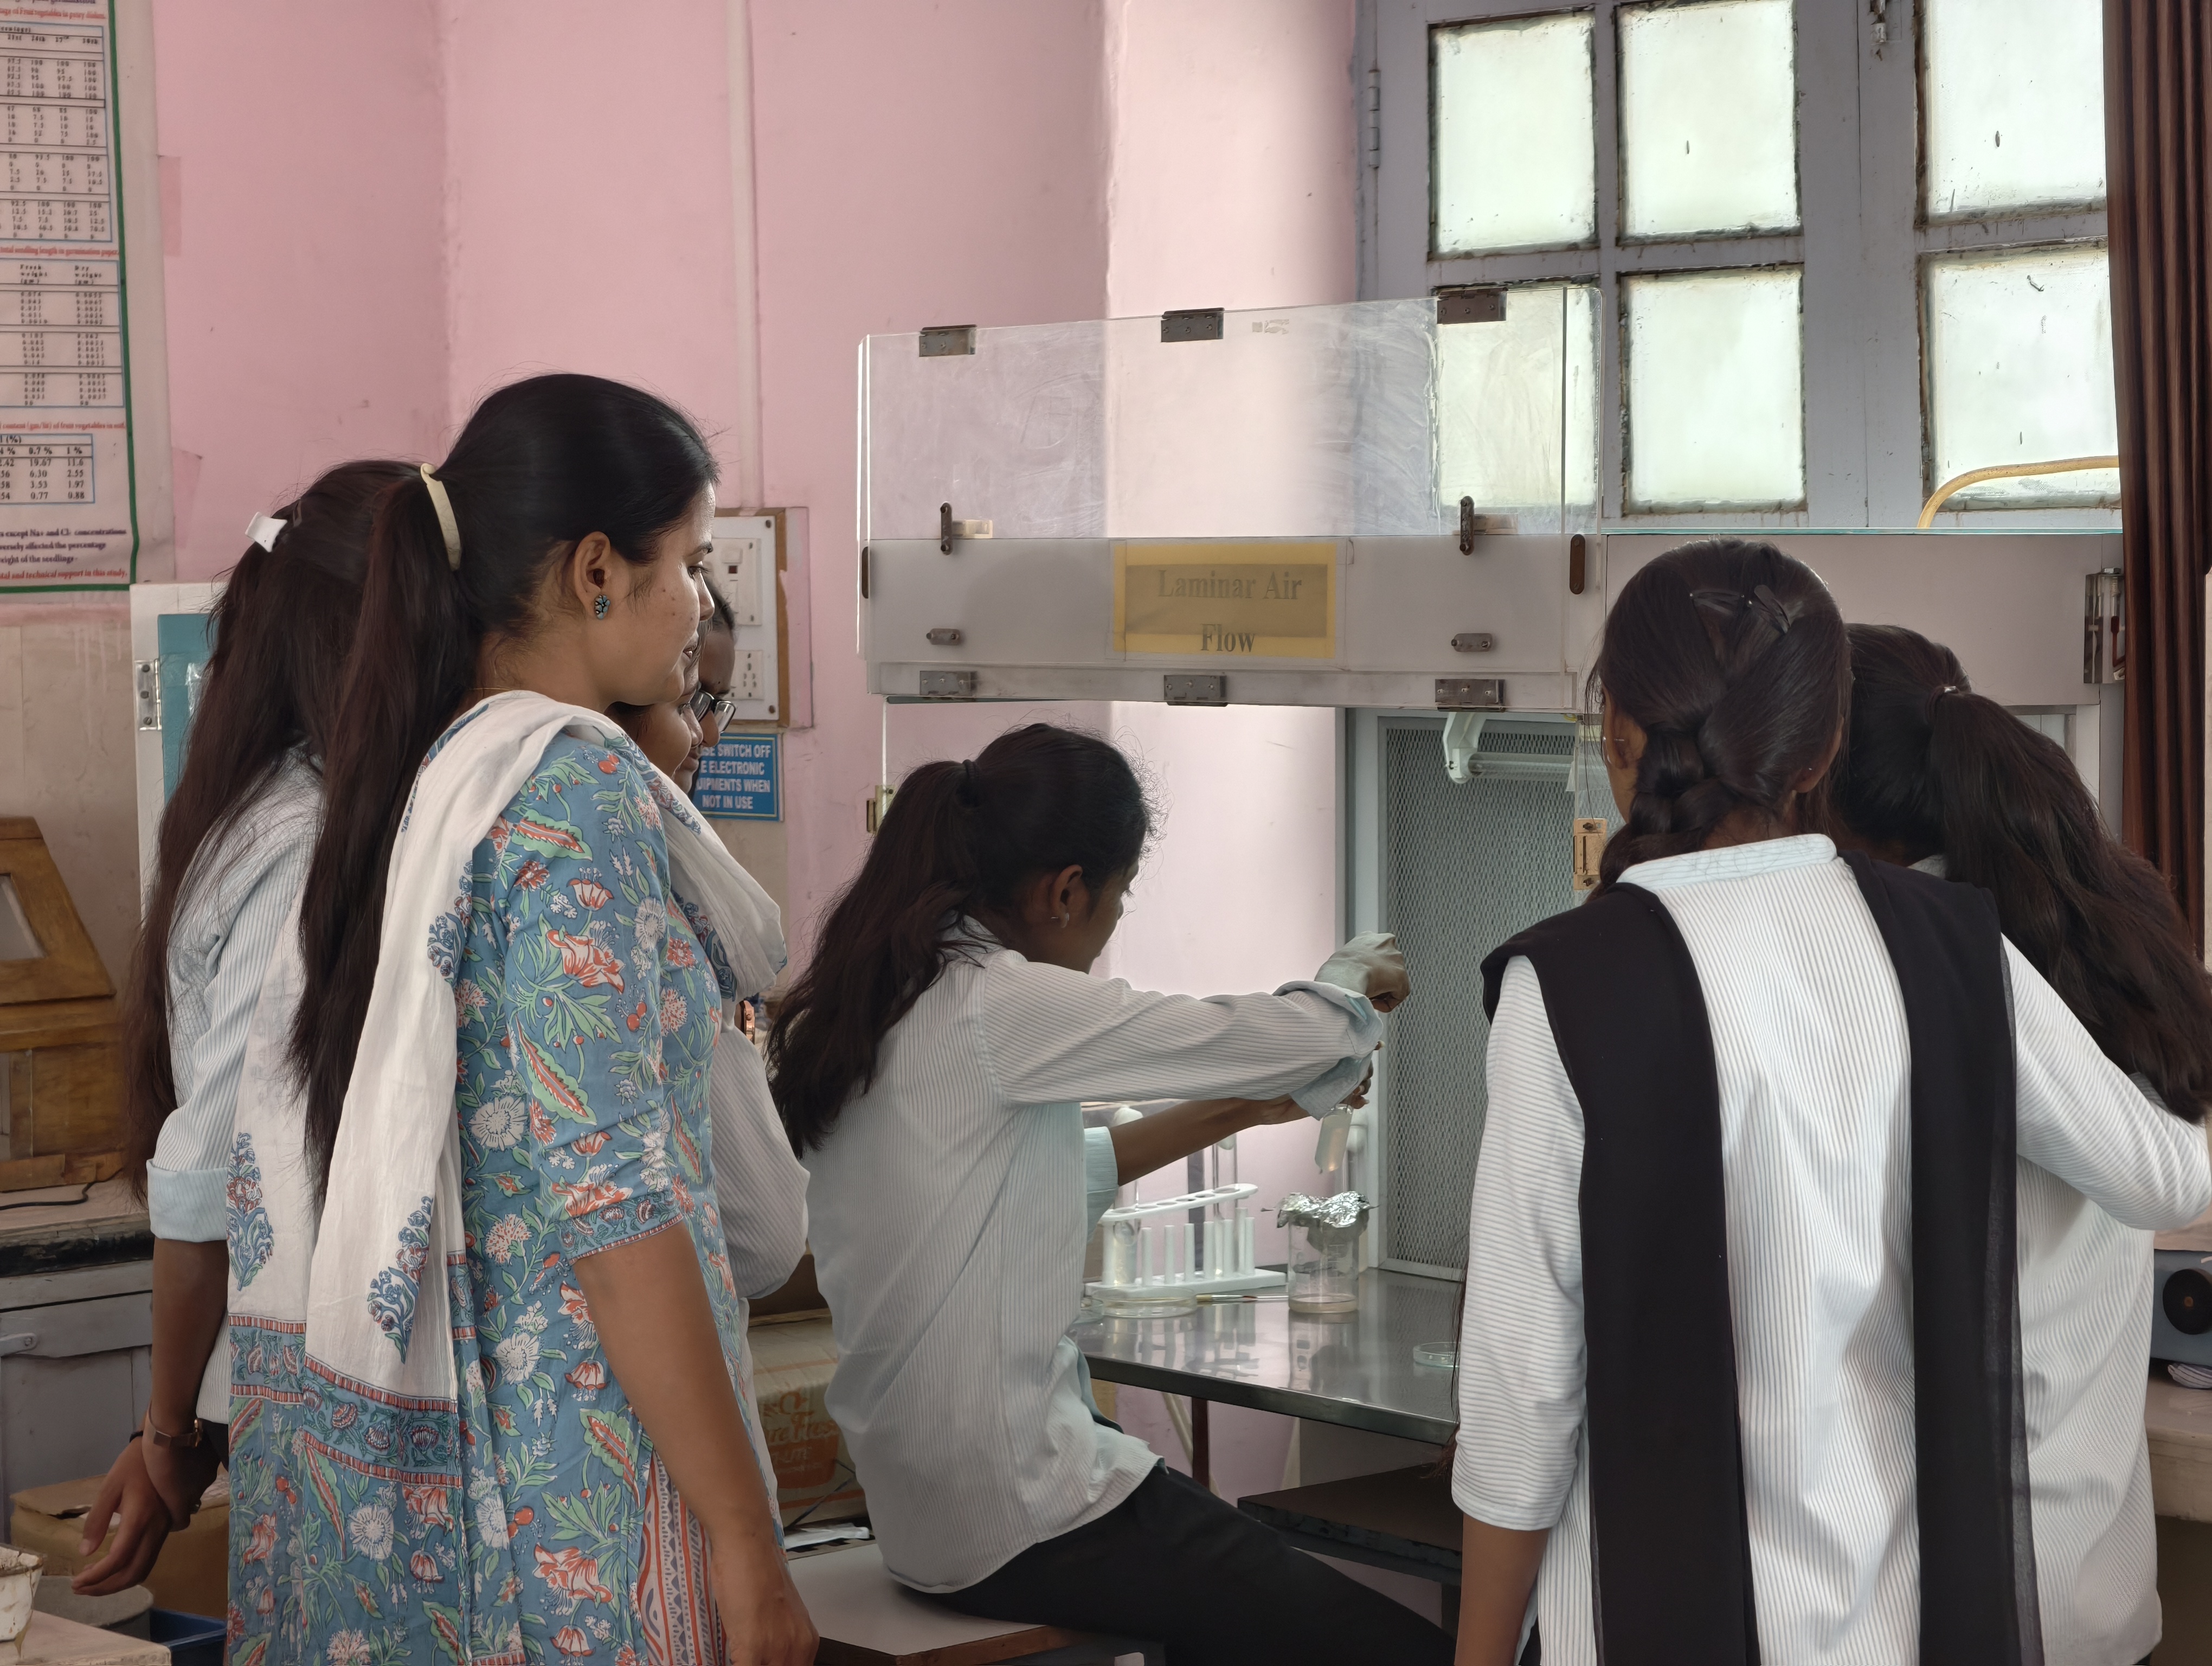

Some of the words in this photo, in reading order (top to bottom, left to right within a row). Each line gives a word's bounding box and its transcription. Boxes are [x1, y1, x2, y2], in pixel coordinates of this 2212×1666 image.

[29, 447, 41, 455] 0.7
[67, 458, 83, 466] 11.6
[30, 470, 47, 478] 6.30
[30, 480, 48, 489] 3.53
[29, 554, 40, 562] the
[12, 570, 24, 579] and
[26, 569, 57, 578] technical
[57, 570, 83, 579] support
[1158, 570, 1256, 598] Laminar
[1263, 571, 1302, 600] Air
[1200, 623, 1255, 652] Flow
[717, 744, 752, 758] SWITCH
[754, 745, 771, 758] OFF
[709, 760, 764, 776] ELECTRONIC
[697, 778, 742, 792] UIPMENTS
[743, 779, 770, 792] WHEN
[702, 794, 721, 808] NOT
[723, 795, 733, 809] IN
[735, 796, 753, 809] USE
